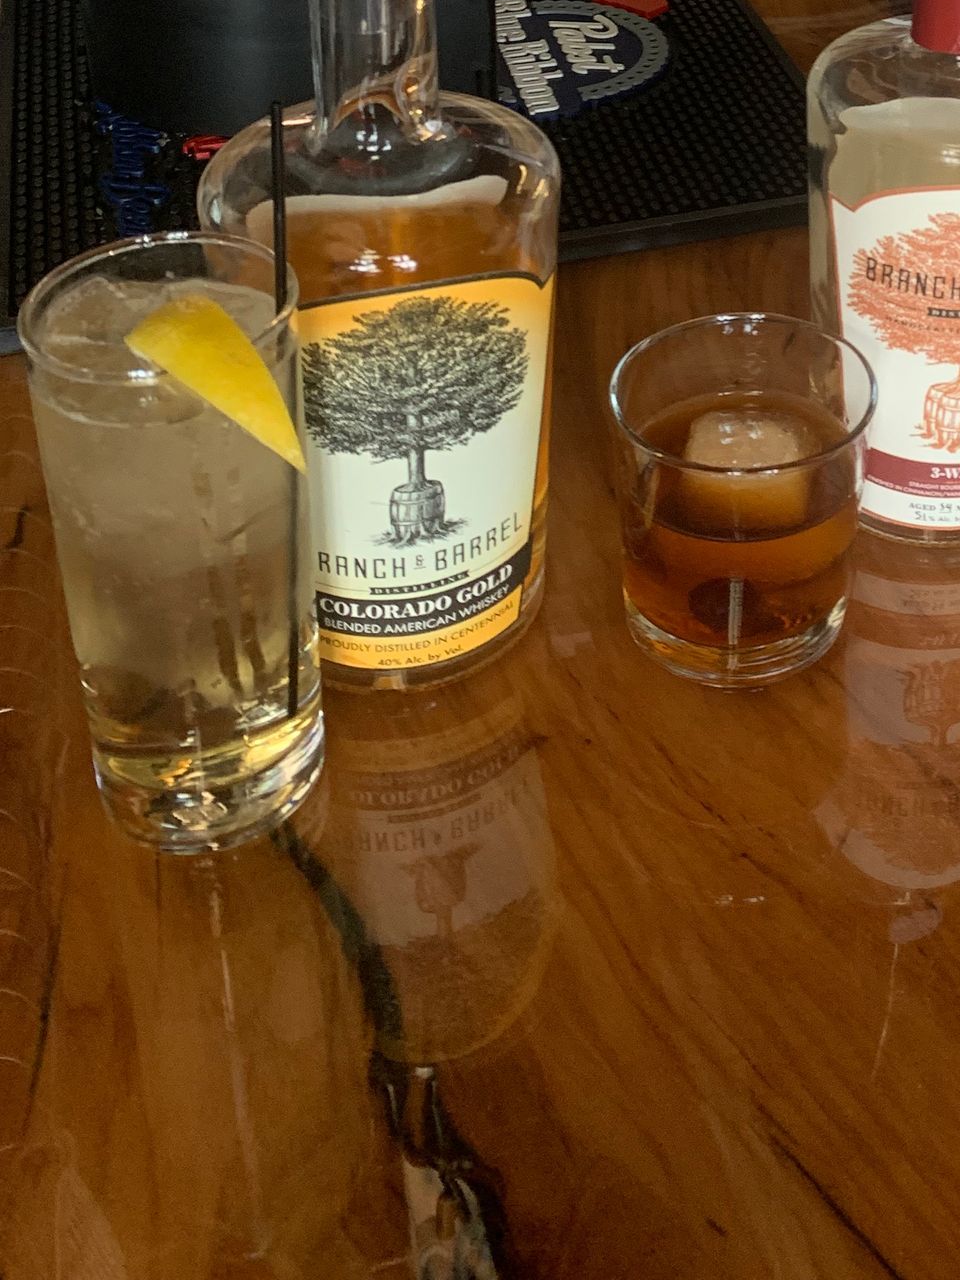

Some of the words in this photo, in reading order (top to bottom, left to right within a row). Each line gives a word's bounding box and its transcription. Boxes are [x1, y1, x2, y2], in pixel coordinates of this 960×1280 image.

[548, 14, 626, 75] Pabst
[499, 38, 564, 115] Ribbon
[908, 502, 937, 512] AGED
[317, 551, 406, 579] RANCH
[435, 512, 522, 571] BARREL
[319, 595, 452, 620] COLORADO
[456, 564, 513, 604] GOLD
[374, 572, 467, 595] DISTILLING
[324, 618, 381, 634] BLENDED
[384, 612, 457, 634] AMERICAN
[458, 584, 510, 616] WHISKEY
[320, 636, 371, 652] PROUDLY
[375, 640, 431, 653] DISTILLED
[434, 635, 448, 646] IN
[378, 658, 401, 666] 40%
[405, 655, 424, 665] Alc.
[428, 650, 441, 662] by
